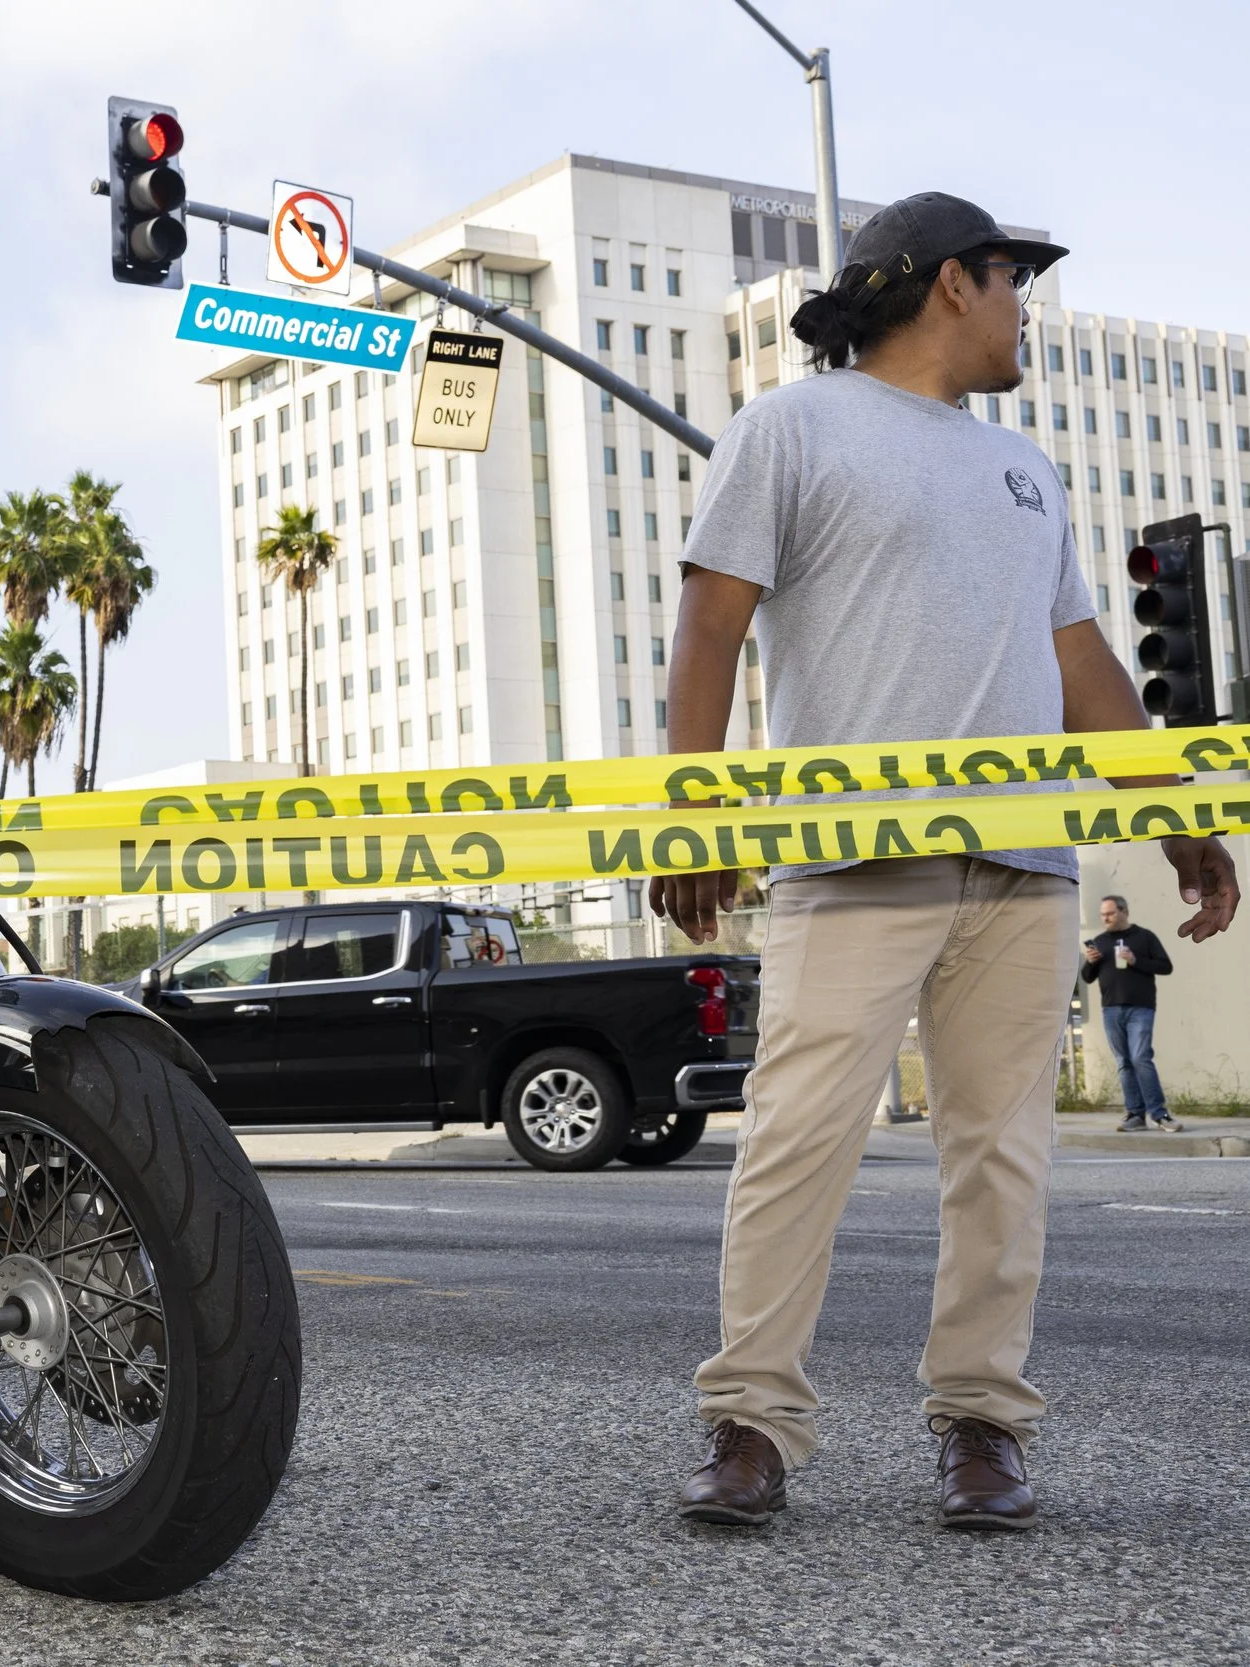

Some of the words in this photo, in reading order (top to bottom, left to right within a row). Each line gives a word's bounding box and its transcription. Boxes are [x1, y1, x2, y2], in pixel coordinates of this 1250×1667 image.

[729, 193, 817, 222] METROPOLITA
[194, 297, 363, 352] Commercial
[367, 323, 402, 358] St
[432, 340, 464, 357] RIGHT
[468, 344, 498, 361] LANE
[442, 379, 476, 399] BUS
[433, 407, 477, 428] ONLY
